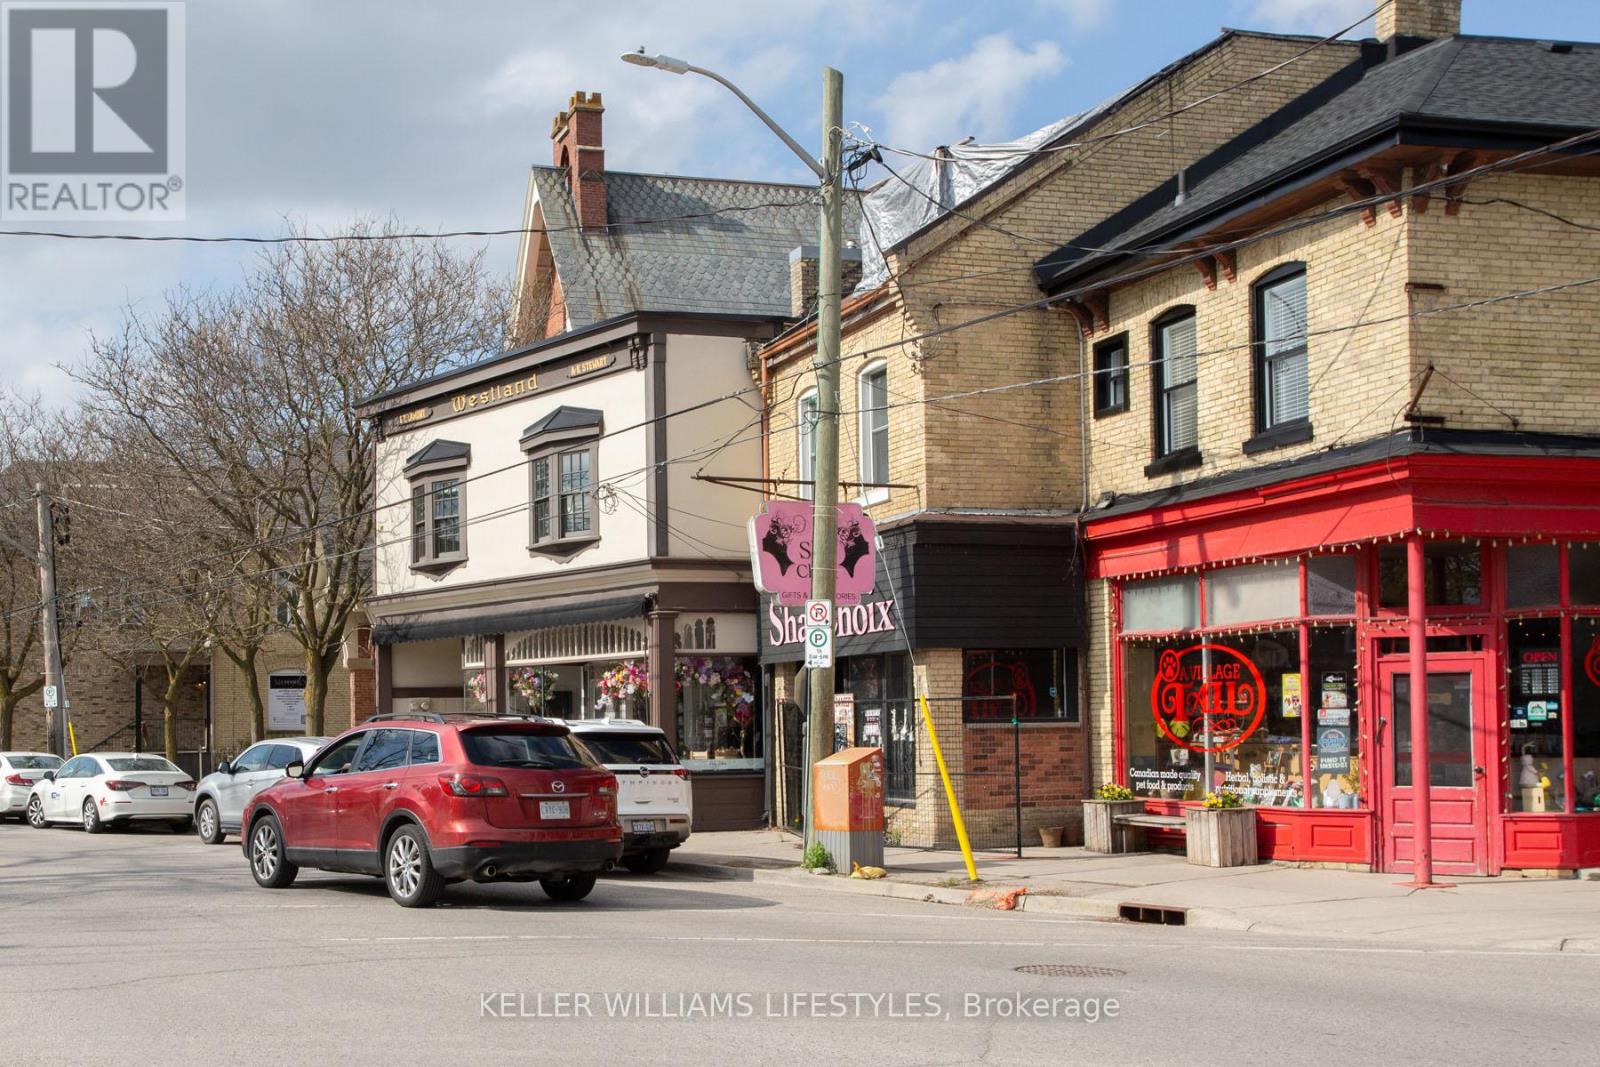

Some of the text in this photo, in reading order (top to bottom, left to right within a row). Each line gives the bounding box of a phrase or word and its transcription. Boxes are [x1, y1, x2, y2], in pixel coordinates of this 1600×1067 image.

[452, 373, 538, 412] Westland
[814, 633, 823, 644] P
[1523, 652, 1558, 662] OPEN
[1180, 667, 1188, 680] A
[1129, 768, 1201, 782] Canadian made quality
[1279, 773, 1286, 784] &
[1136, 779, 1195, 792] pet food & products
